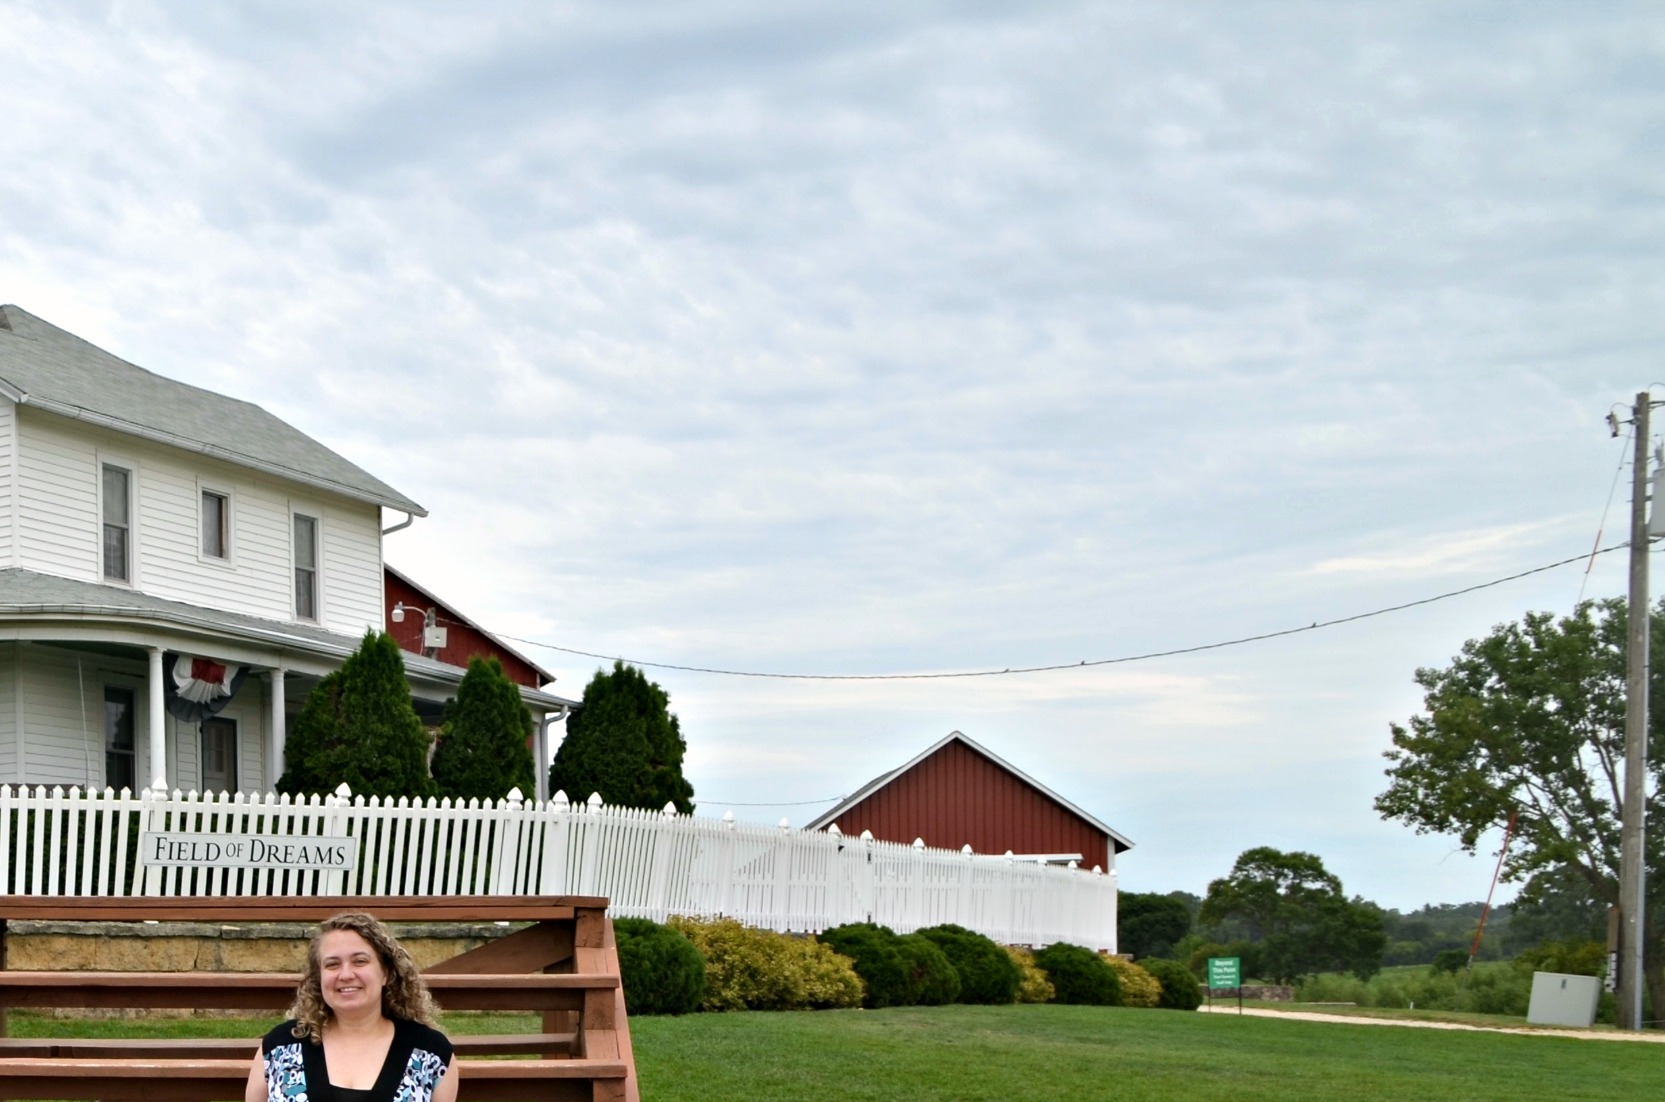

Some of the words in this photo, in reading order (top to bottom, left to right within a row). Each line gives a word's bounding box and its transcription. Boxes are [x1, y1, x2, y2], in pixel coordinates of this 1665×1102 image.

[154, 836, 221, 862] FIELD
[225, 842, 244, 858] OF
[248, 838, 346, 865] DREAMS
